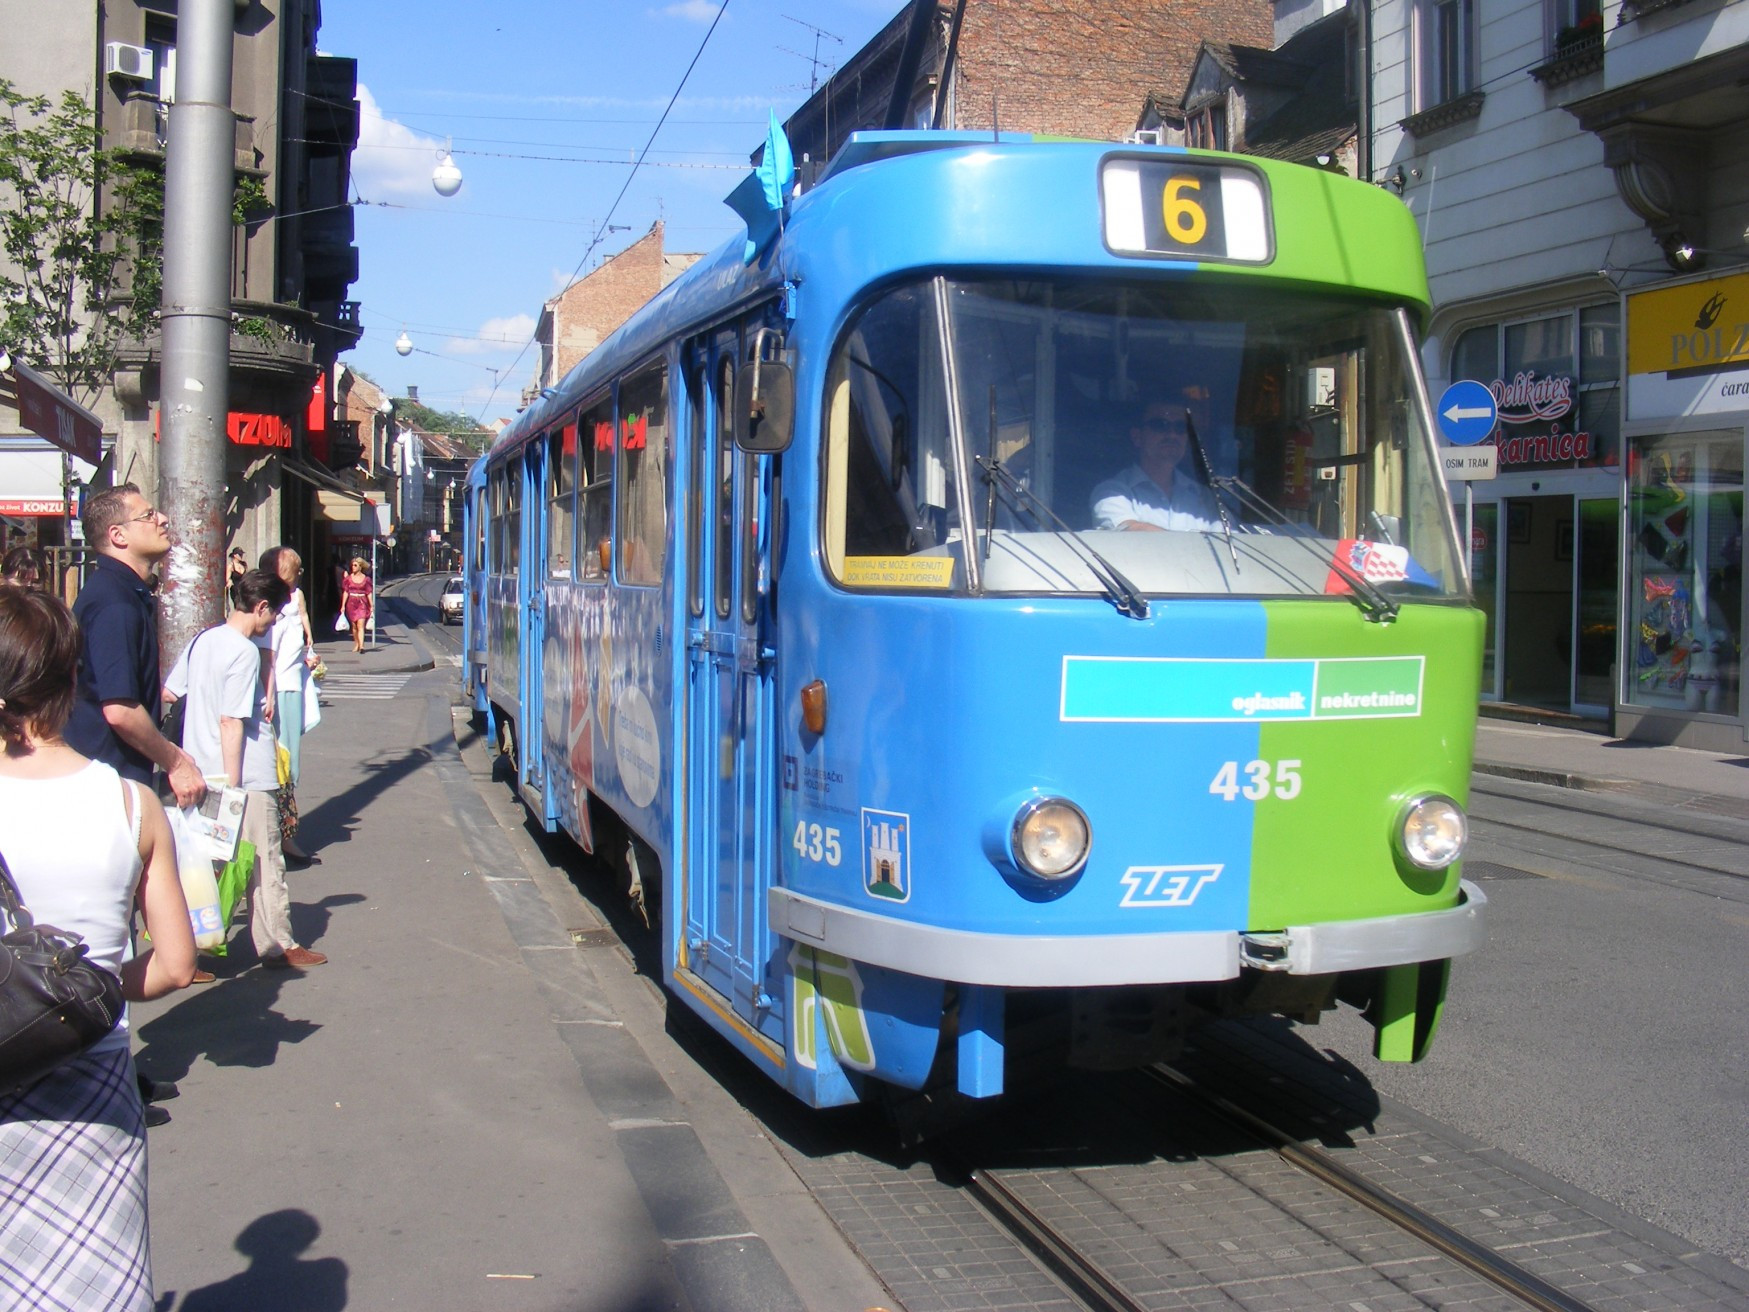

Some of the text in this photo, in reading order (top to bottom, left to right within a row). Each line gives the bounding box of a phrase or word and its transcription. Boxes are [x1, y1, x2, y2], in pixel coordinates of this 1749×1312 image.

[1163, 174, 1207, 244] 6
[1490, 370, 1571, 414] Delikates
[1446, 458, 1488, 468] OSIM TRAM
[1483, 423, 1589, 465] karnica
[899, 573, 943, 583] ZATVORENA
[911, 561, 944, 570] KRENUTI
[1232, 692, 1306, 715] oglasnik
[1321, 691, 1416, 709] nekretnine
[1209, 759, 1302, 801] 435
[793, 820, 842, 867] 435
[1118, 863, 1225, 907] ZET
